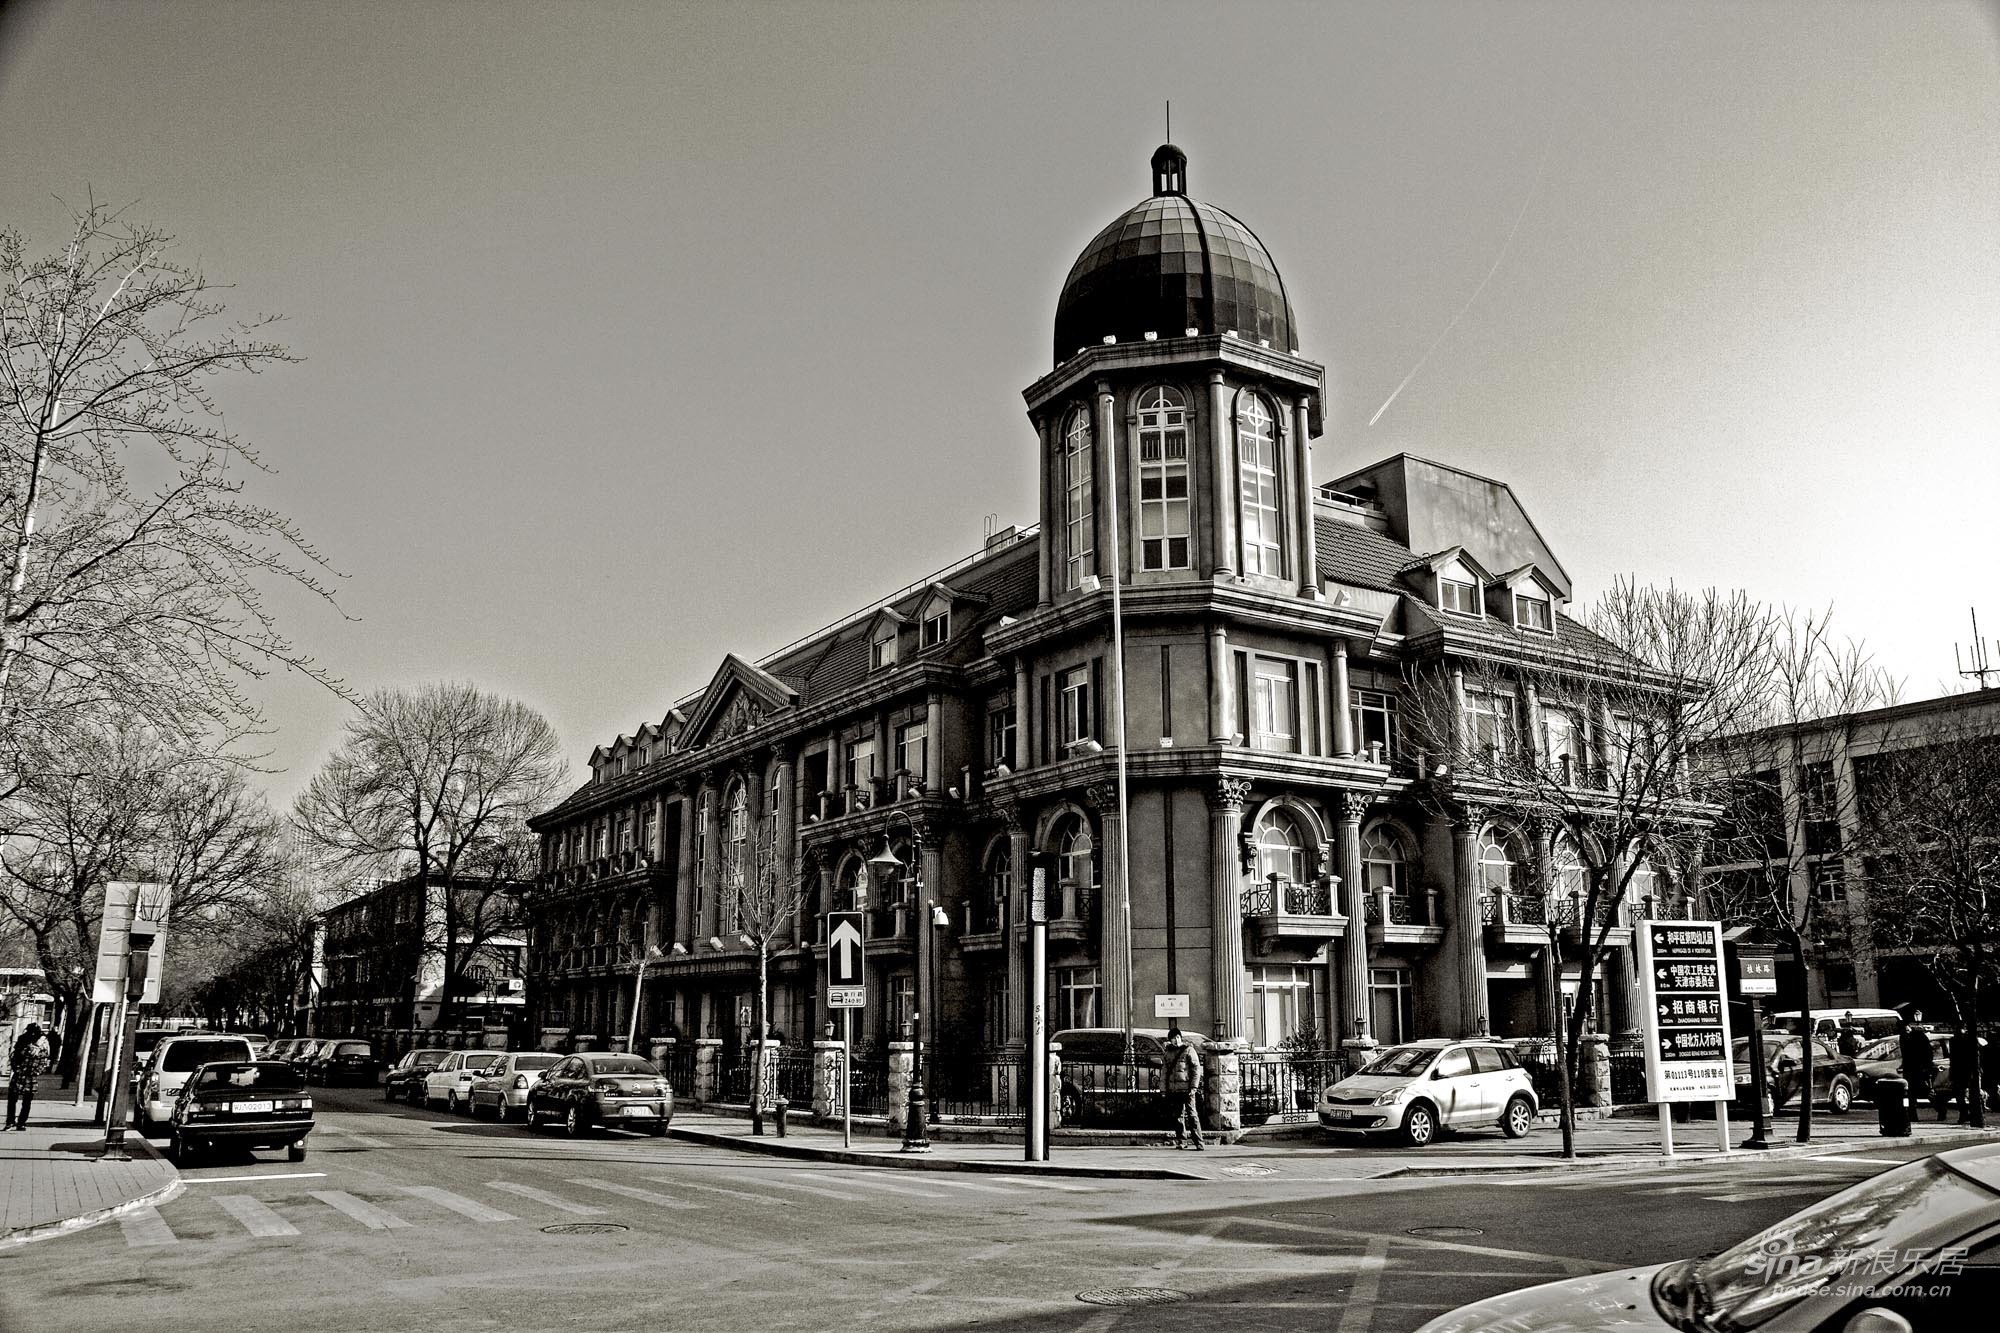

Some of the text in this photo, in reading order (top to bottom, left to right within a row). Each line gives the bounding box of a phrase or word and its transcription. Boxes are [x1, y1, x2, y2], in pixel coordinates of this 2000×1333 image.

[1667, 930, 1714, 945] 和平区第四幼儿园
[1670, 964, 1717, 976] 中国农工民主党
[1675, 975, 1715, 988] 天津市委员会
[1672, 999, 1720, 1015] 招商银行
[1675, 1032, 1722, 1048] 中国北方人才市场
